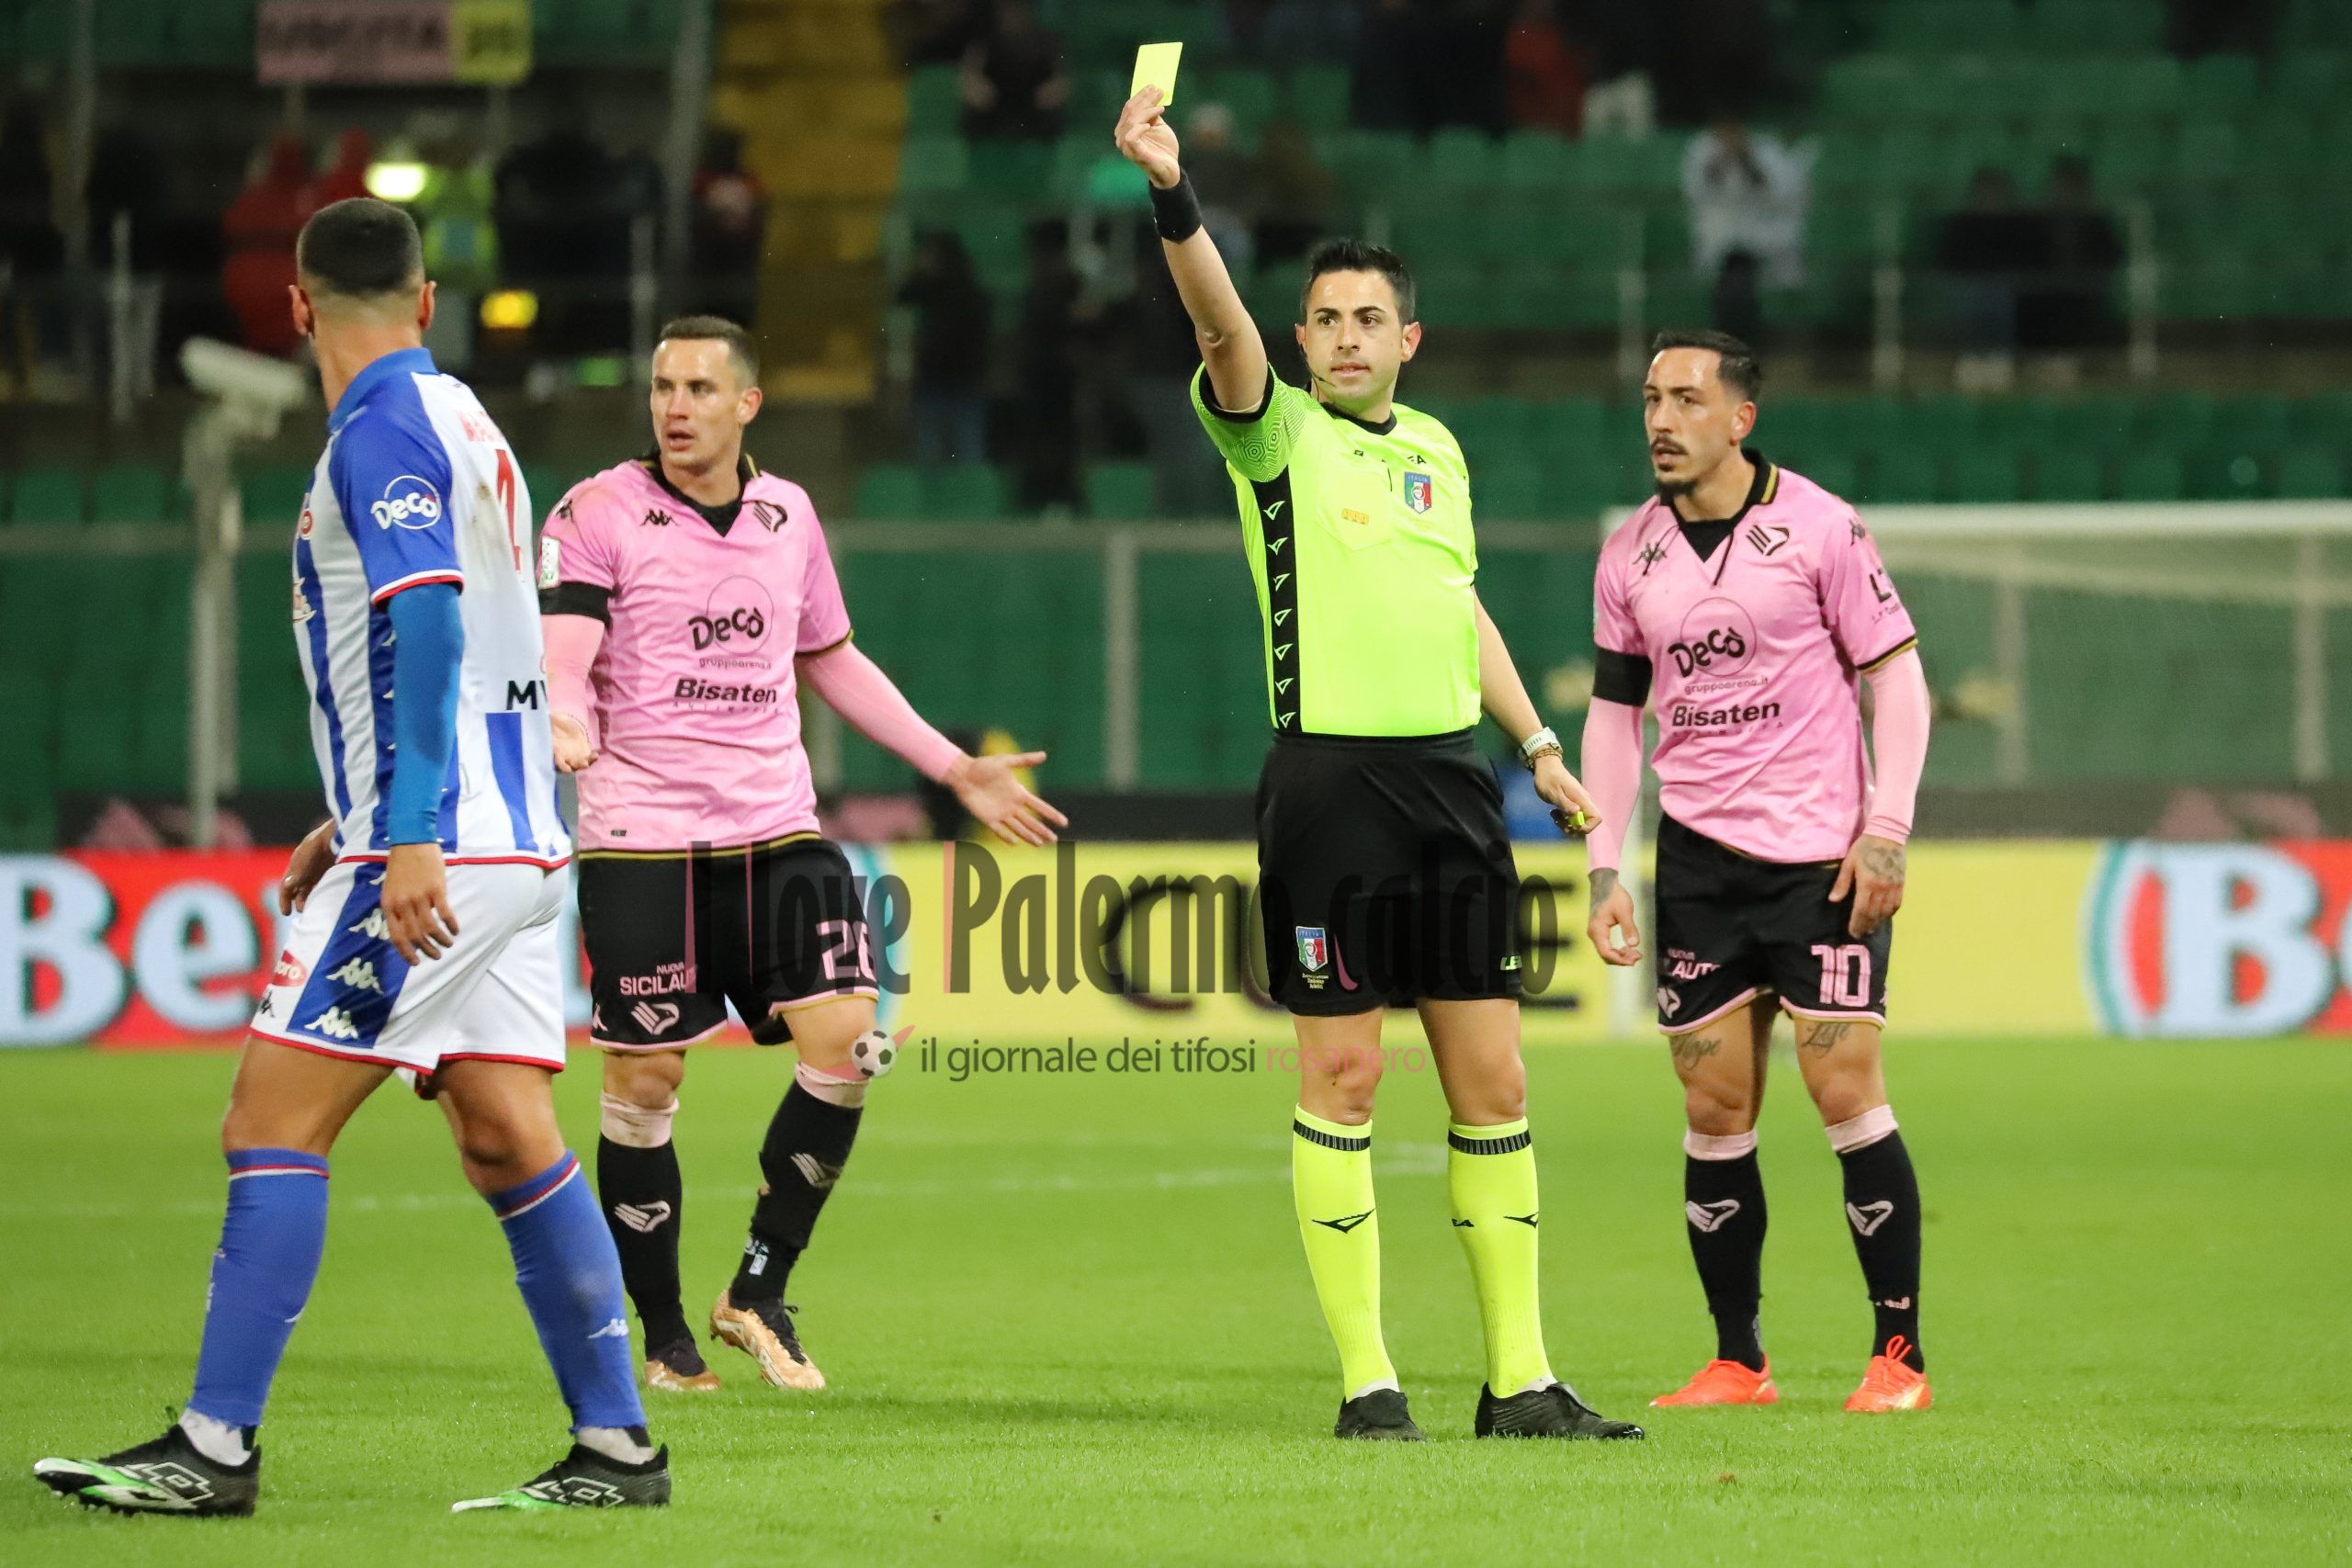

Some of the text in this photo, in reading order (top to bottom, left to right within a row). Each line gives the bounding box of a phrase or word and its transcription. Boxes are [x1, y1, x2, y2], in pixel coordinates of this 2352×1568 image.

[673, 677, 777, 704] Bisaten
[1672, 702, 1781, 727] Bisaten
[1810, 943, 1871, 1008] 10
